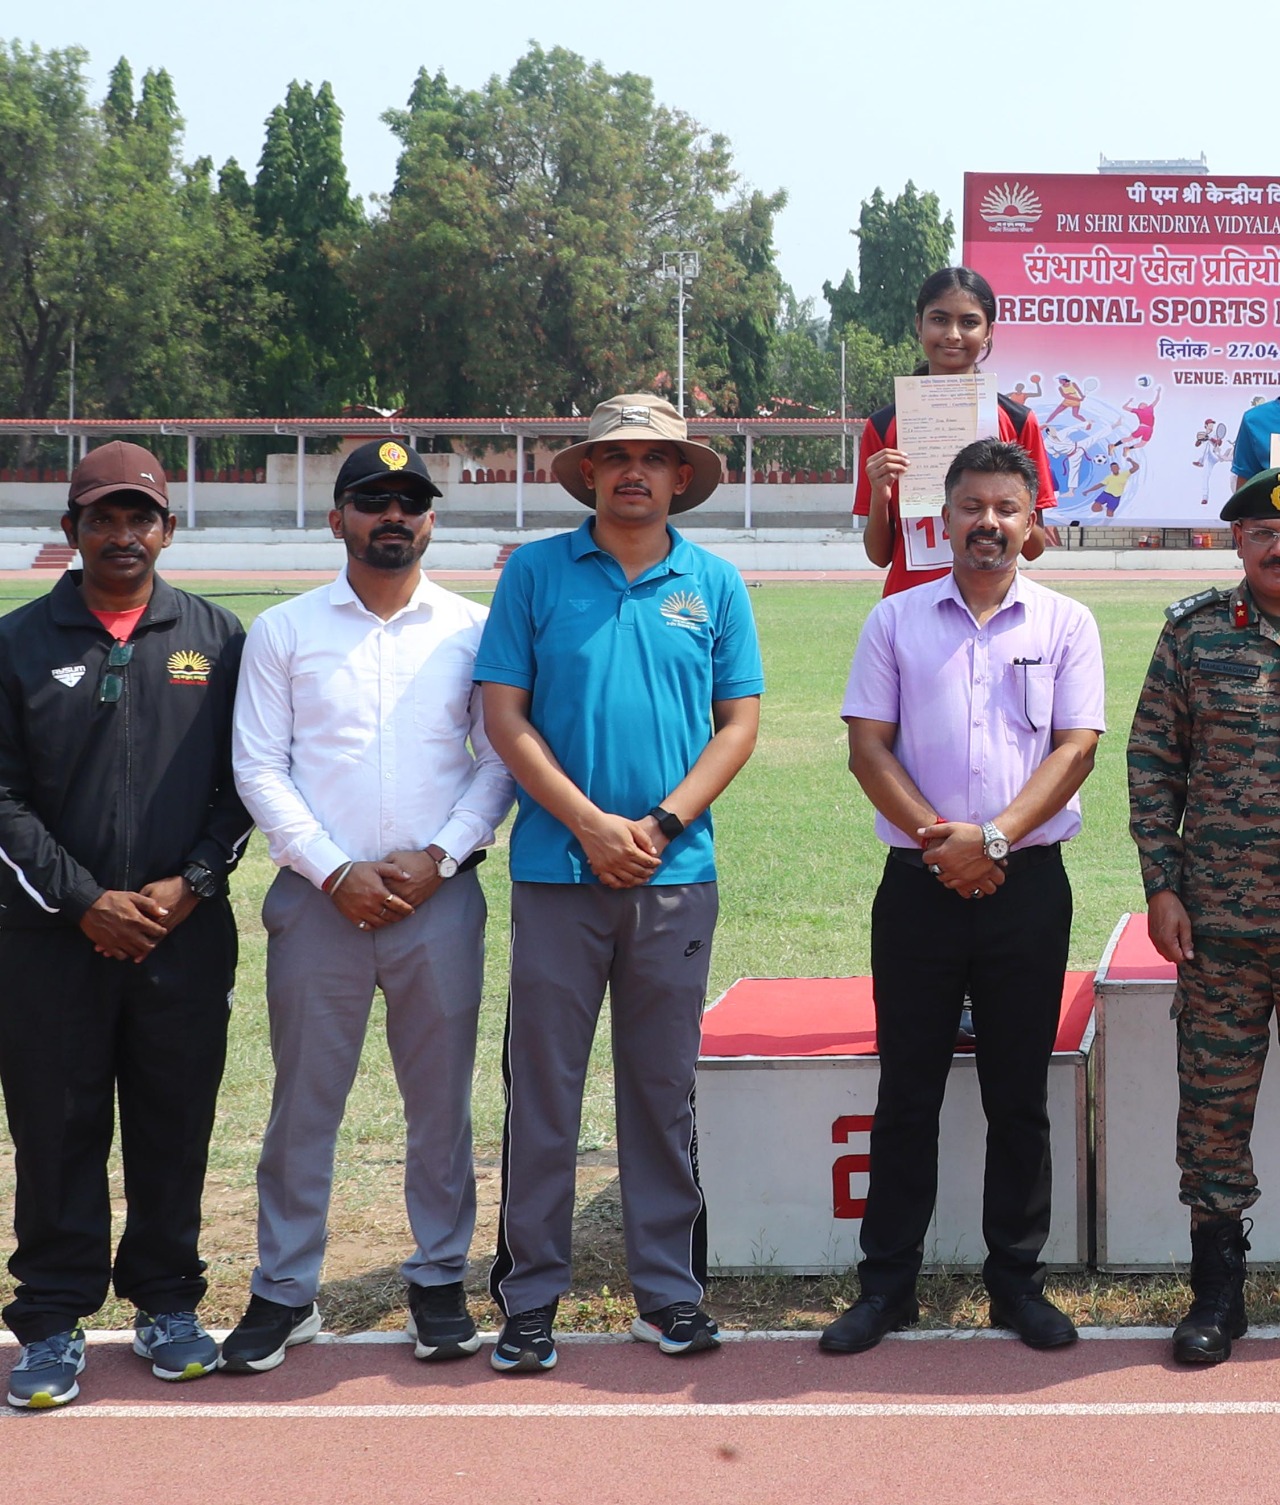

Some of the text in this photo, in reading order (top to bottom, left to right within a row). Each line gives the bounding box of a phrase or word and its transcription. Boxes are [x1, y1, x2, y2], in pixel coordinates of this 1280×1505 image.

[1126, 182, 1147, 204] पी
[1150, 186, 1181, 205] एम
[1182, 182, 1202, 206] श्री
[1205, 182, 1262, 206] केन्द्रीय
[1056, 213, 1080, 232] PM
[1085, 214, 1124, 233] SHRI
[1128, 214, 1210, 235] KENDRIYA
[1024, 245, 1133, 284] संभागीय
[1140, 245, 1196, 287] खेल
[998, 298, 1142, 324] REGIONAL
[1152, 300, 1266, 325] SPORTS
[1159, 339, 1207, 358] दिनांक
[1174, 371, 1228, 385] VENUE:
